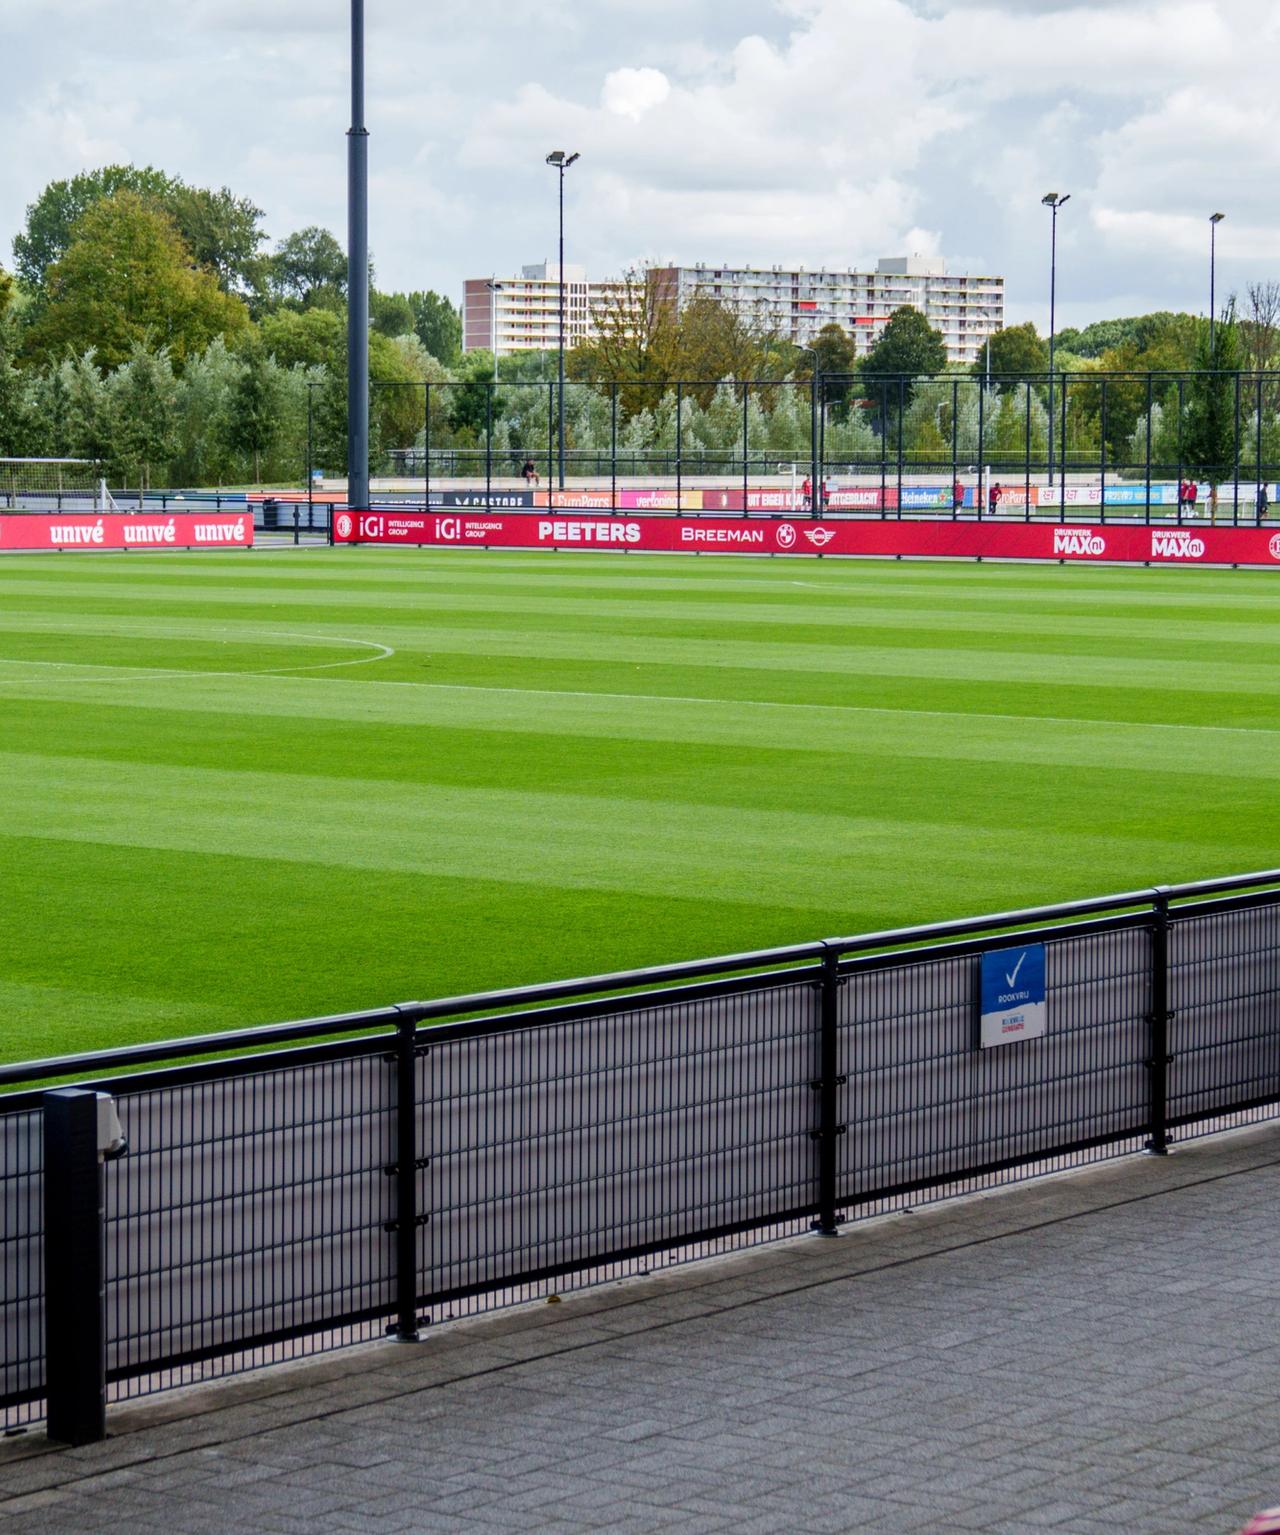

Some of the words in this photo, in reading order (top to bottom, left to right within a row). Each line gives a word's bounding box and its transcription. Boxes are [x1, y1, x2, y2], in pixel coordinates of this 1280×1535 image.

[388, 520, 425, 528] INTELLIGENCE
[465, 522, 503, 530] INTELLIGENCE
[50, 519, 104, 543] univé
[123, 519, 175, 543] univé
[194, 517, 245, 541] univé
[388, 528, 408, 536] GROUP
[538, 521, 641, 542] PEETERS
[1054, 528, 1092, 537] DRUKWERK
[465, 530, 486, 538] GROUP
[1152, 531, 1190, 539] DRUKWERK
[998, 991, 1030, 1004] ROOKVRIJ
